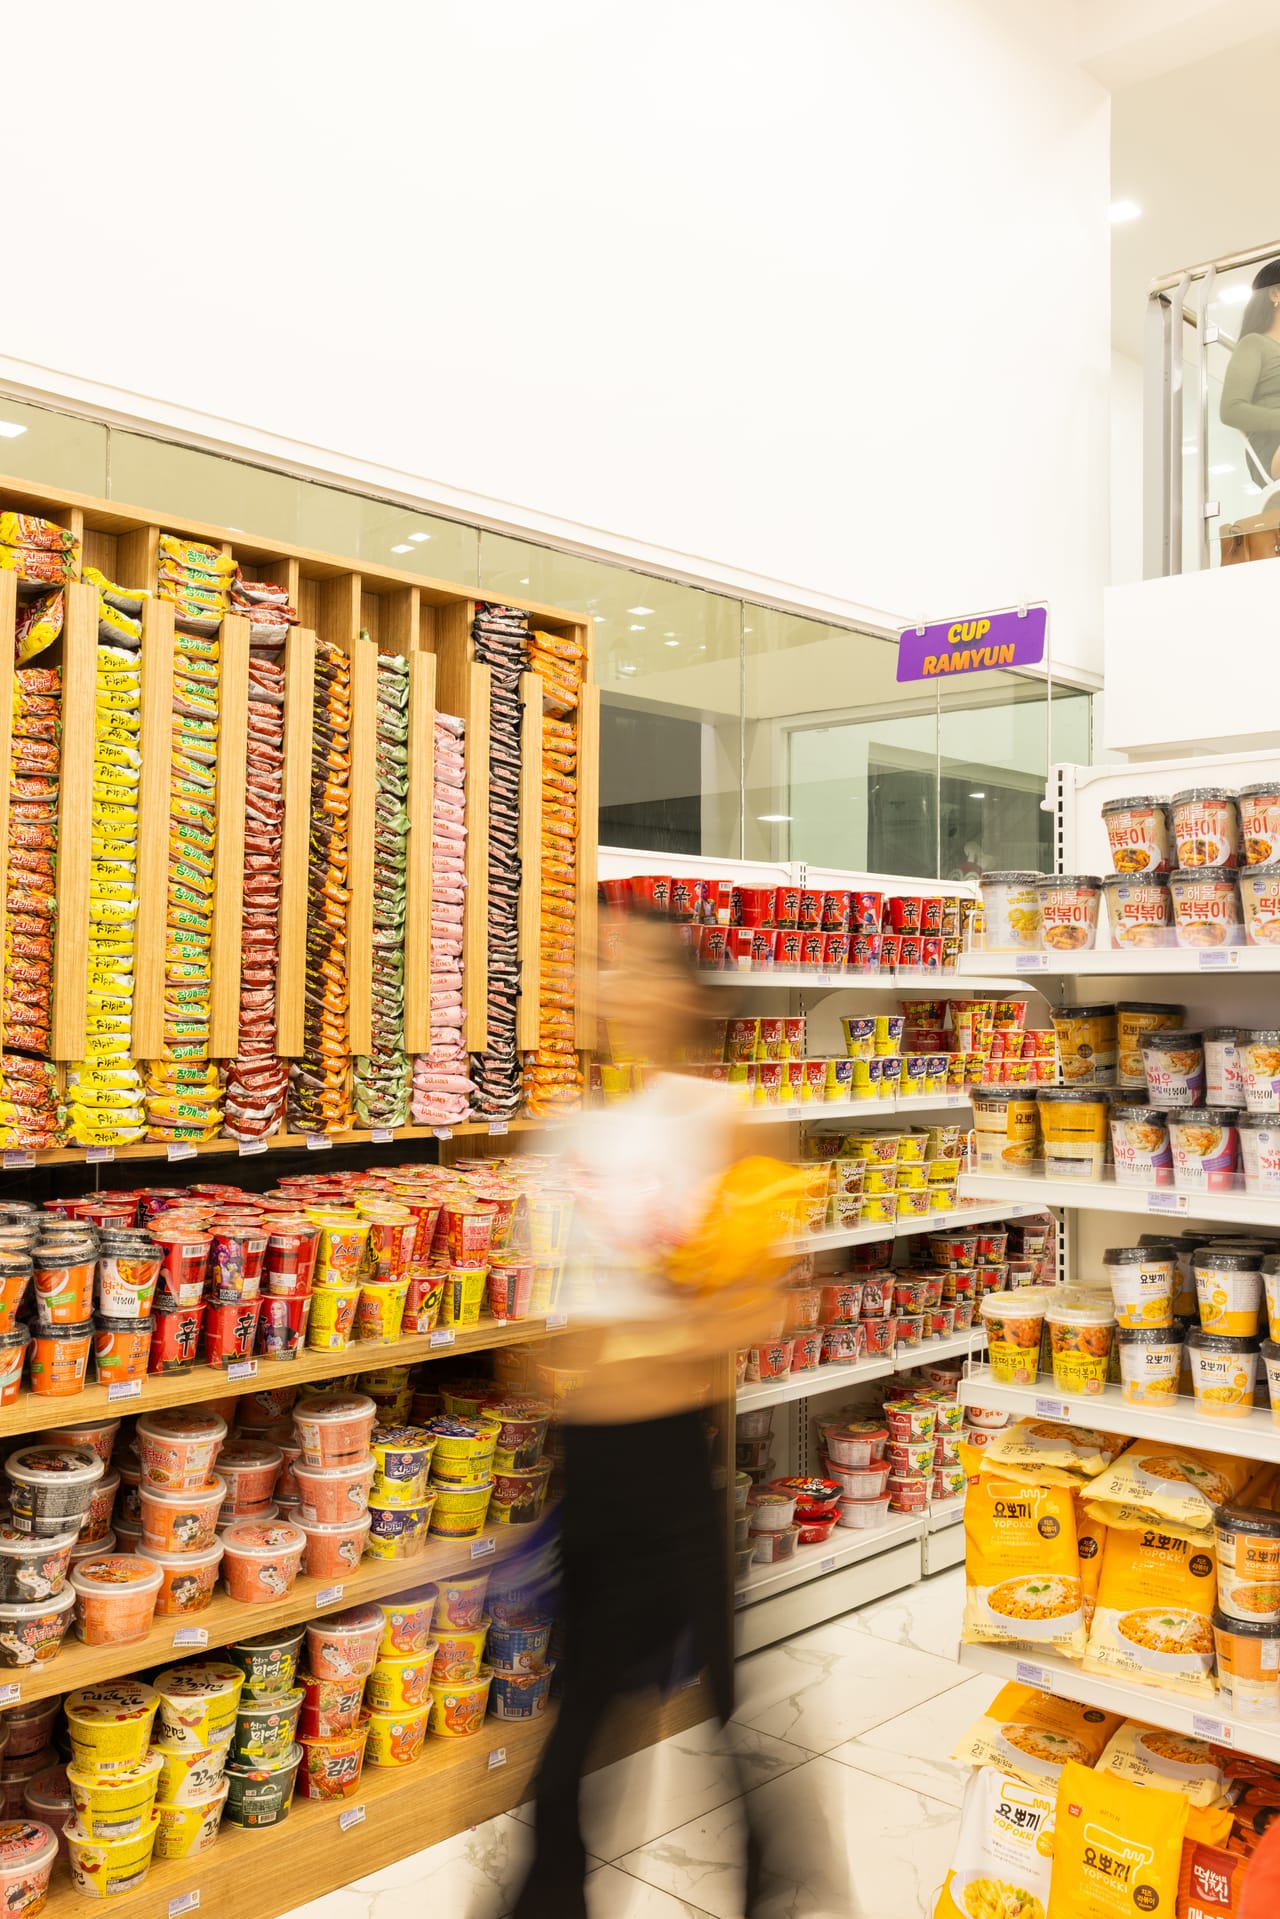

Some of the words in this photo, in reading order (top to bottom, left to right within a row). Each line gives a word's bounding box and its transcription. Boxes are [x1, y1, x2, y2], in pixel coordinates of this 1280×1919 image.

[947, 619, 991, 644] CUP
[922, 643, 1016, 676] RAMYUN
[1179, 802, 1205, 820] 해물
[1176, 819, 1217, 838] 떡볶이
[672, 883, 692, 912] 辛
[1051, 891, 1078, 905] 해물
[1134, 889, 1161, 903] 해물
[1187, 885, 1217, 901] 해물
[1270, 883, 1280, 899] 해
[784, 892, 799, 919] 辛
[800, 895, 818, 920] 辛
[824, 896, 840, 920] 辛
[904, 901, 919, 925] 辛
[926, 903, 941, 926] 辛
[1044, 906, 1088, 923] 떡볶이
[1124, 904, 1167, 921] 떡볶이
[1180, 901, 1226, 919] 떡볶이
[708, 932, 725, 961] 辛
[752, 935, 769, 961] 辛
[784, 935, 800, 961] 辛
[806, 937, 822, 962] 辛
[828, 938, 845, 964] 辛
[854, 939, 870, 964] 辛
[881, 940, 897, 963] 辛
[902, 942, 918, 965] 辛
[176, 1068, 208, 1080] 참깨라면
[178, 1104, 208, 1120] 참깨라면
[174, 1127, 204, 1139] 참깨라면
[1140, 1273, 1165, 1285] 요뽀끼
[837, 1291, 851, 1315] 辛
[175, 1318, 200, 1357] 辛
[233, 1312, 257, 1352] 辛
[823, 1332, 838, 1356] 辛
[874, 1324, 890, 1348] 辛
[767, 1347, 785, 1373] 辛
[803, 1339, 817, 1363] 辛
[1145, 1355, 1172, 1365] 요뽀끼
[1200, 1360, 1226, 1373] 요뽀끼
[992, 1501, 1032, 1519] 요뽀끼
[1139, 1530, 1188, 1554] 요뽀끼
[1138, 1548, 1185, 1564] YOPOKKI
[1245, 1549, 1280, 1564] 요뽀끼
[162, 1722, 187, 1741] 꼬면
[327, 1750, 359, 1778] 김치
[992, 1815, 1036, 1841] YOPOKKI
[995, 1803, 1041, 1831] 요뽀끼
[1082, 1847, 1131, 1883] 요뽀끼
[1082, 1866, 1128, 1894] YOPOKKI
